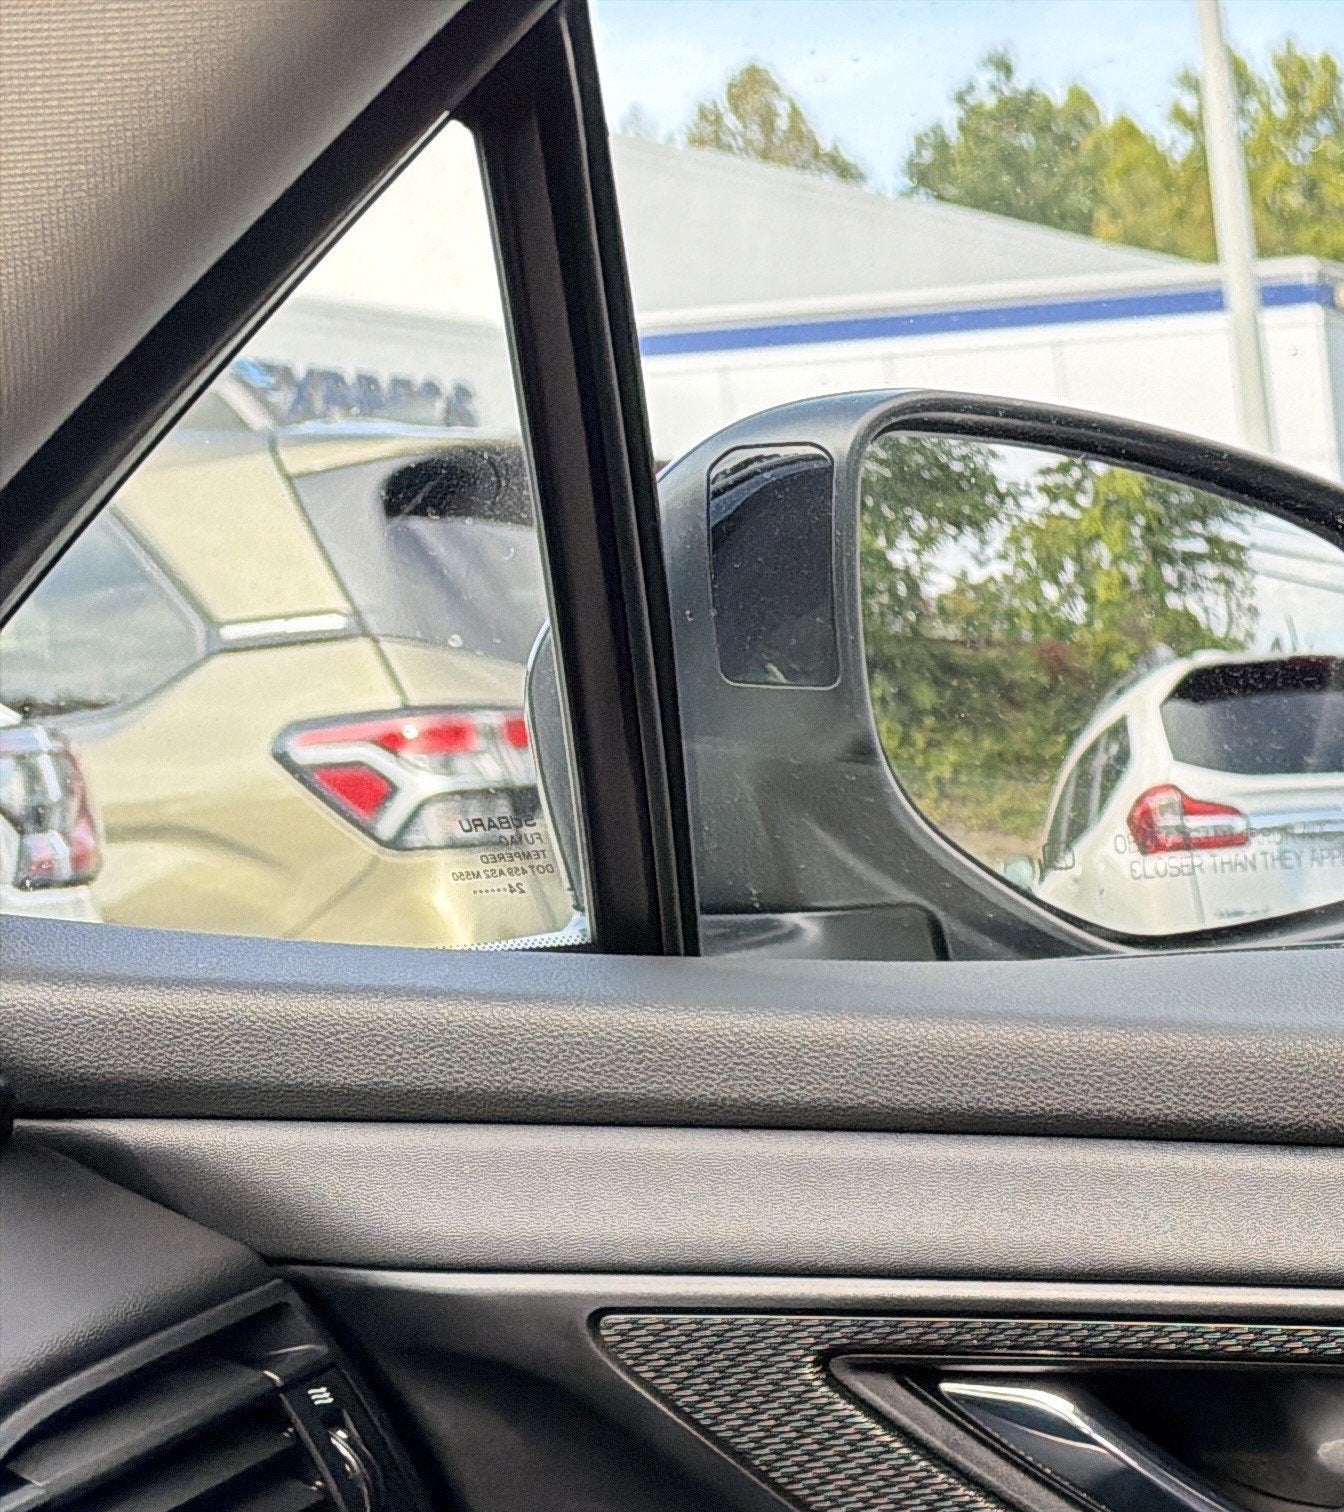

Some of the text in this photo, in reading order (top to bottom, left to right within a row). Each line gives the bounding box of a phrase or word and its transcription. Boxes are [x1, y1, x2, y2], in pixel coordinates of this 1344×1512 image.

[1130, 856, 1204, 880] CLOSER
[1211, 853, 1257, 873] THAN
[1262, 849, 1303, 870] THEY
